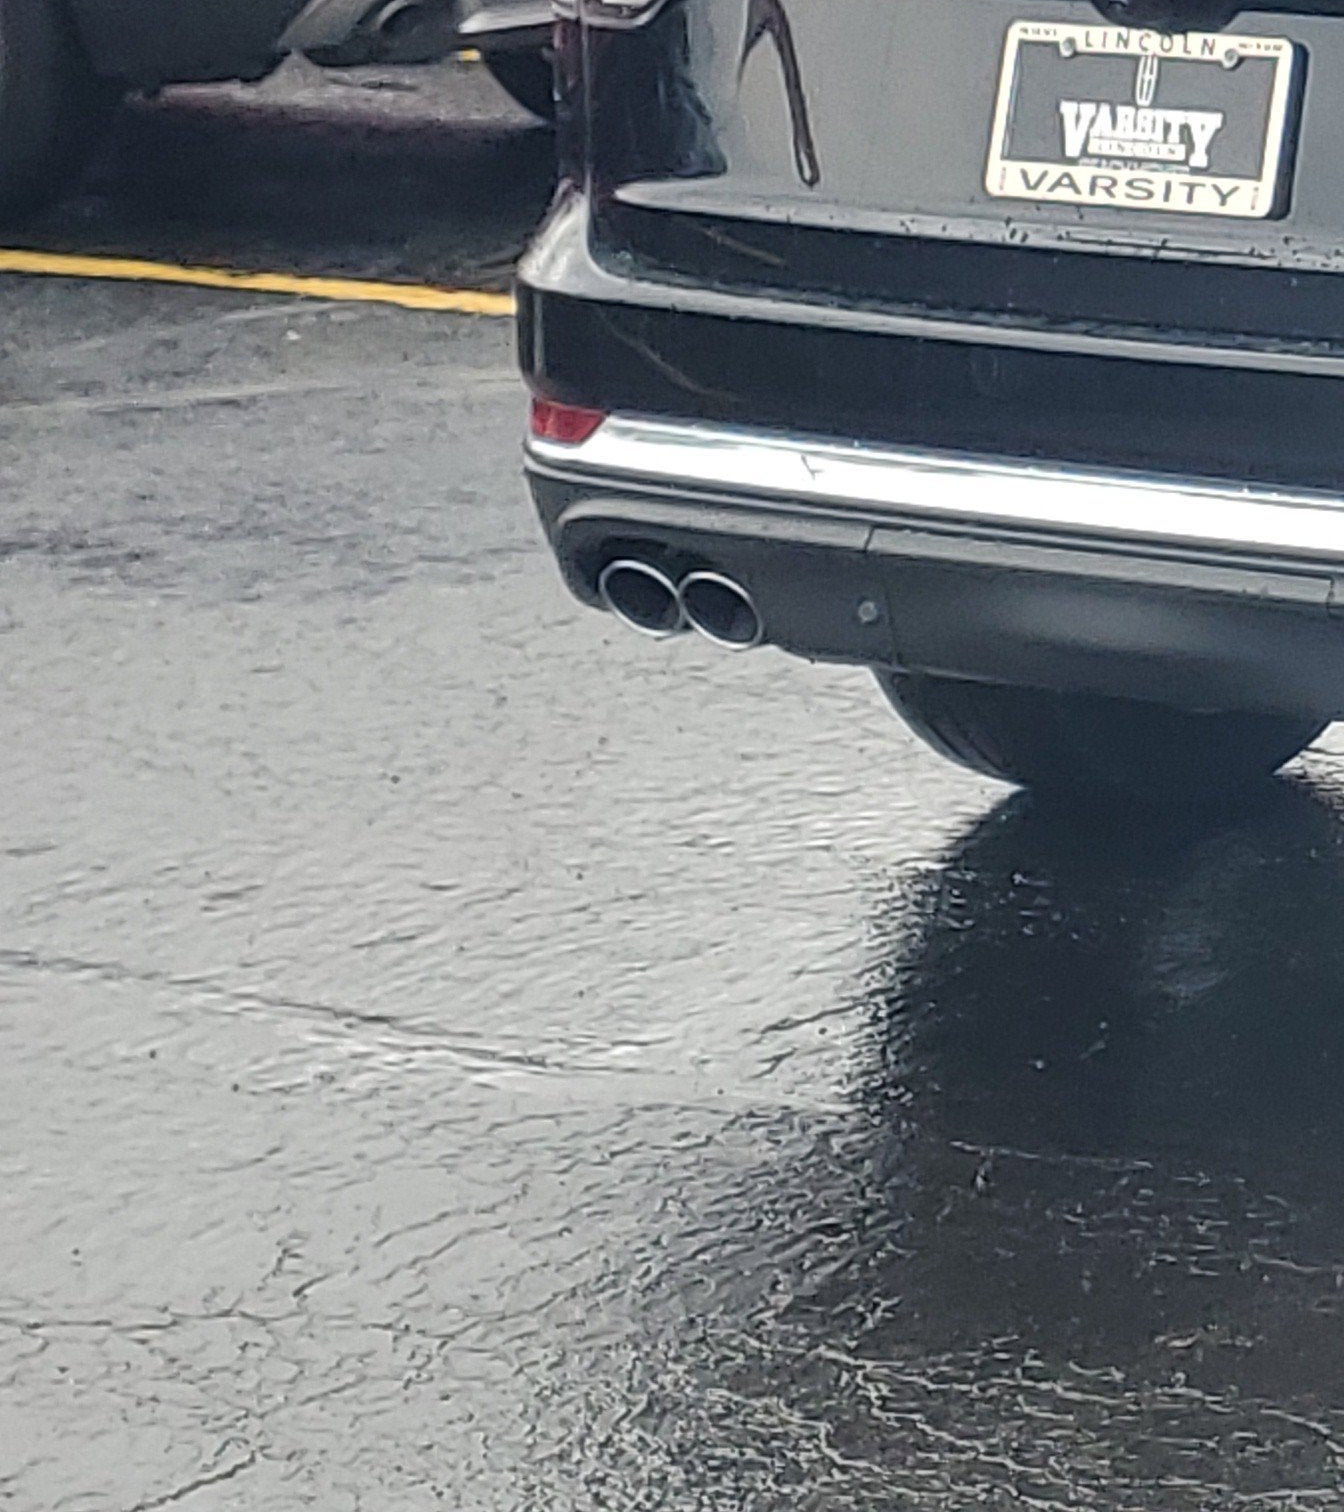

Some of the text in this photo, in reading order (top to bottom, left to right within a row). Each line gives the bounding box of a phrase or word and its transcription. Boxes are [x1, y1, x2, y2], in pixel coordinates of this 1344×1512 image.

[1084, 29, 1216, 56] LINCOLN
[1059, 99, 1224, 168] VARSITY
[1019, 168, 1241, 207] VARSITY
